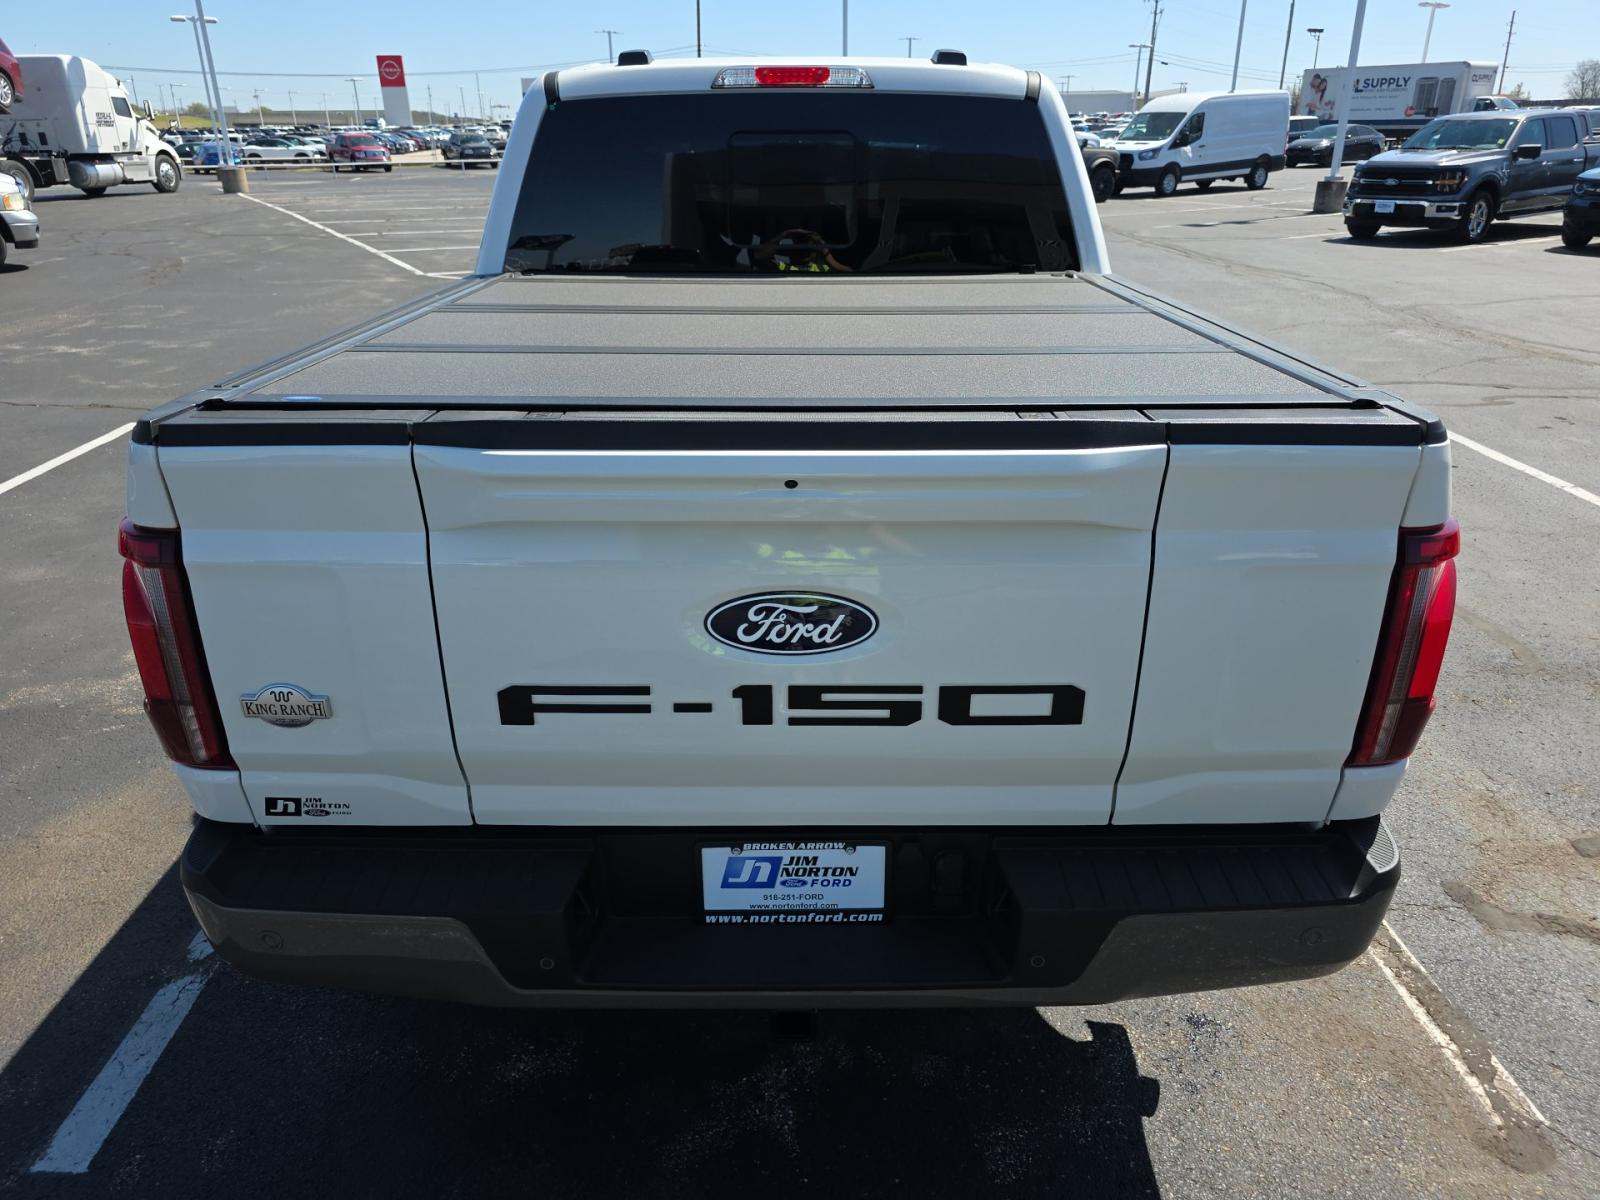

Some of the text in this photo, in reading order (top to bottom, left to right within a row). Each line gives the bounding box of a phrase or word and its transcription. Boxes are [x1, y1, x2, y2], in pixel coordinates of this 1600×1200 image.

[1362, 76, 1411, 89] SUPPLY
[736, 602, 844, 645] Ford
[245, 701, 324, 716] KING RANCH
[497, 684, 1086, 726] F-150
[743, 842, 796, 850] BROKEN
[783, 856, 819, 866] JIM
[780, 867, 859, 877] NORTON
[810, 879, 852, 887] FORD
[705, 912, 883, 923] www.nortonford.com
